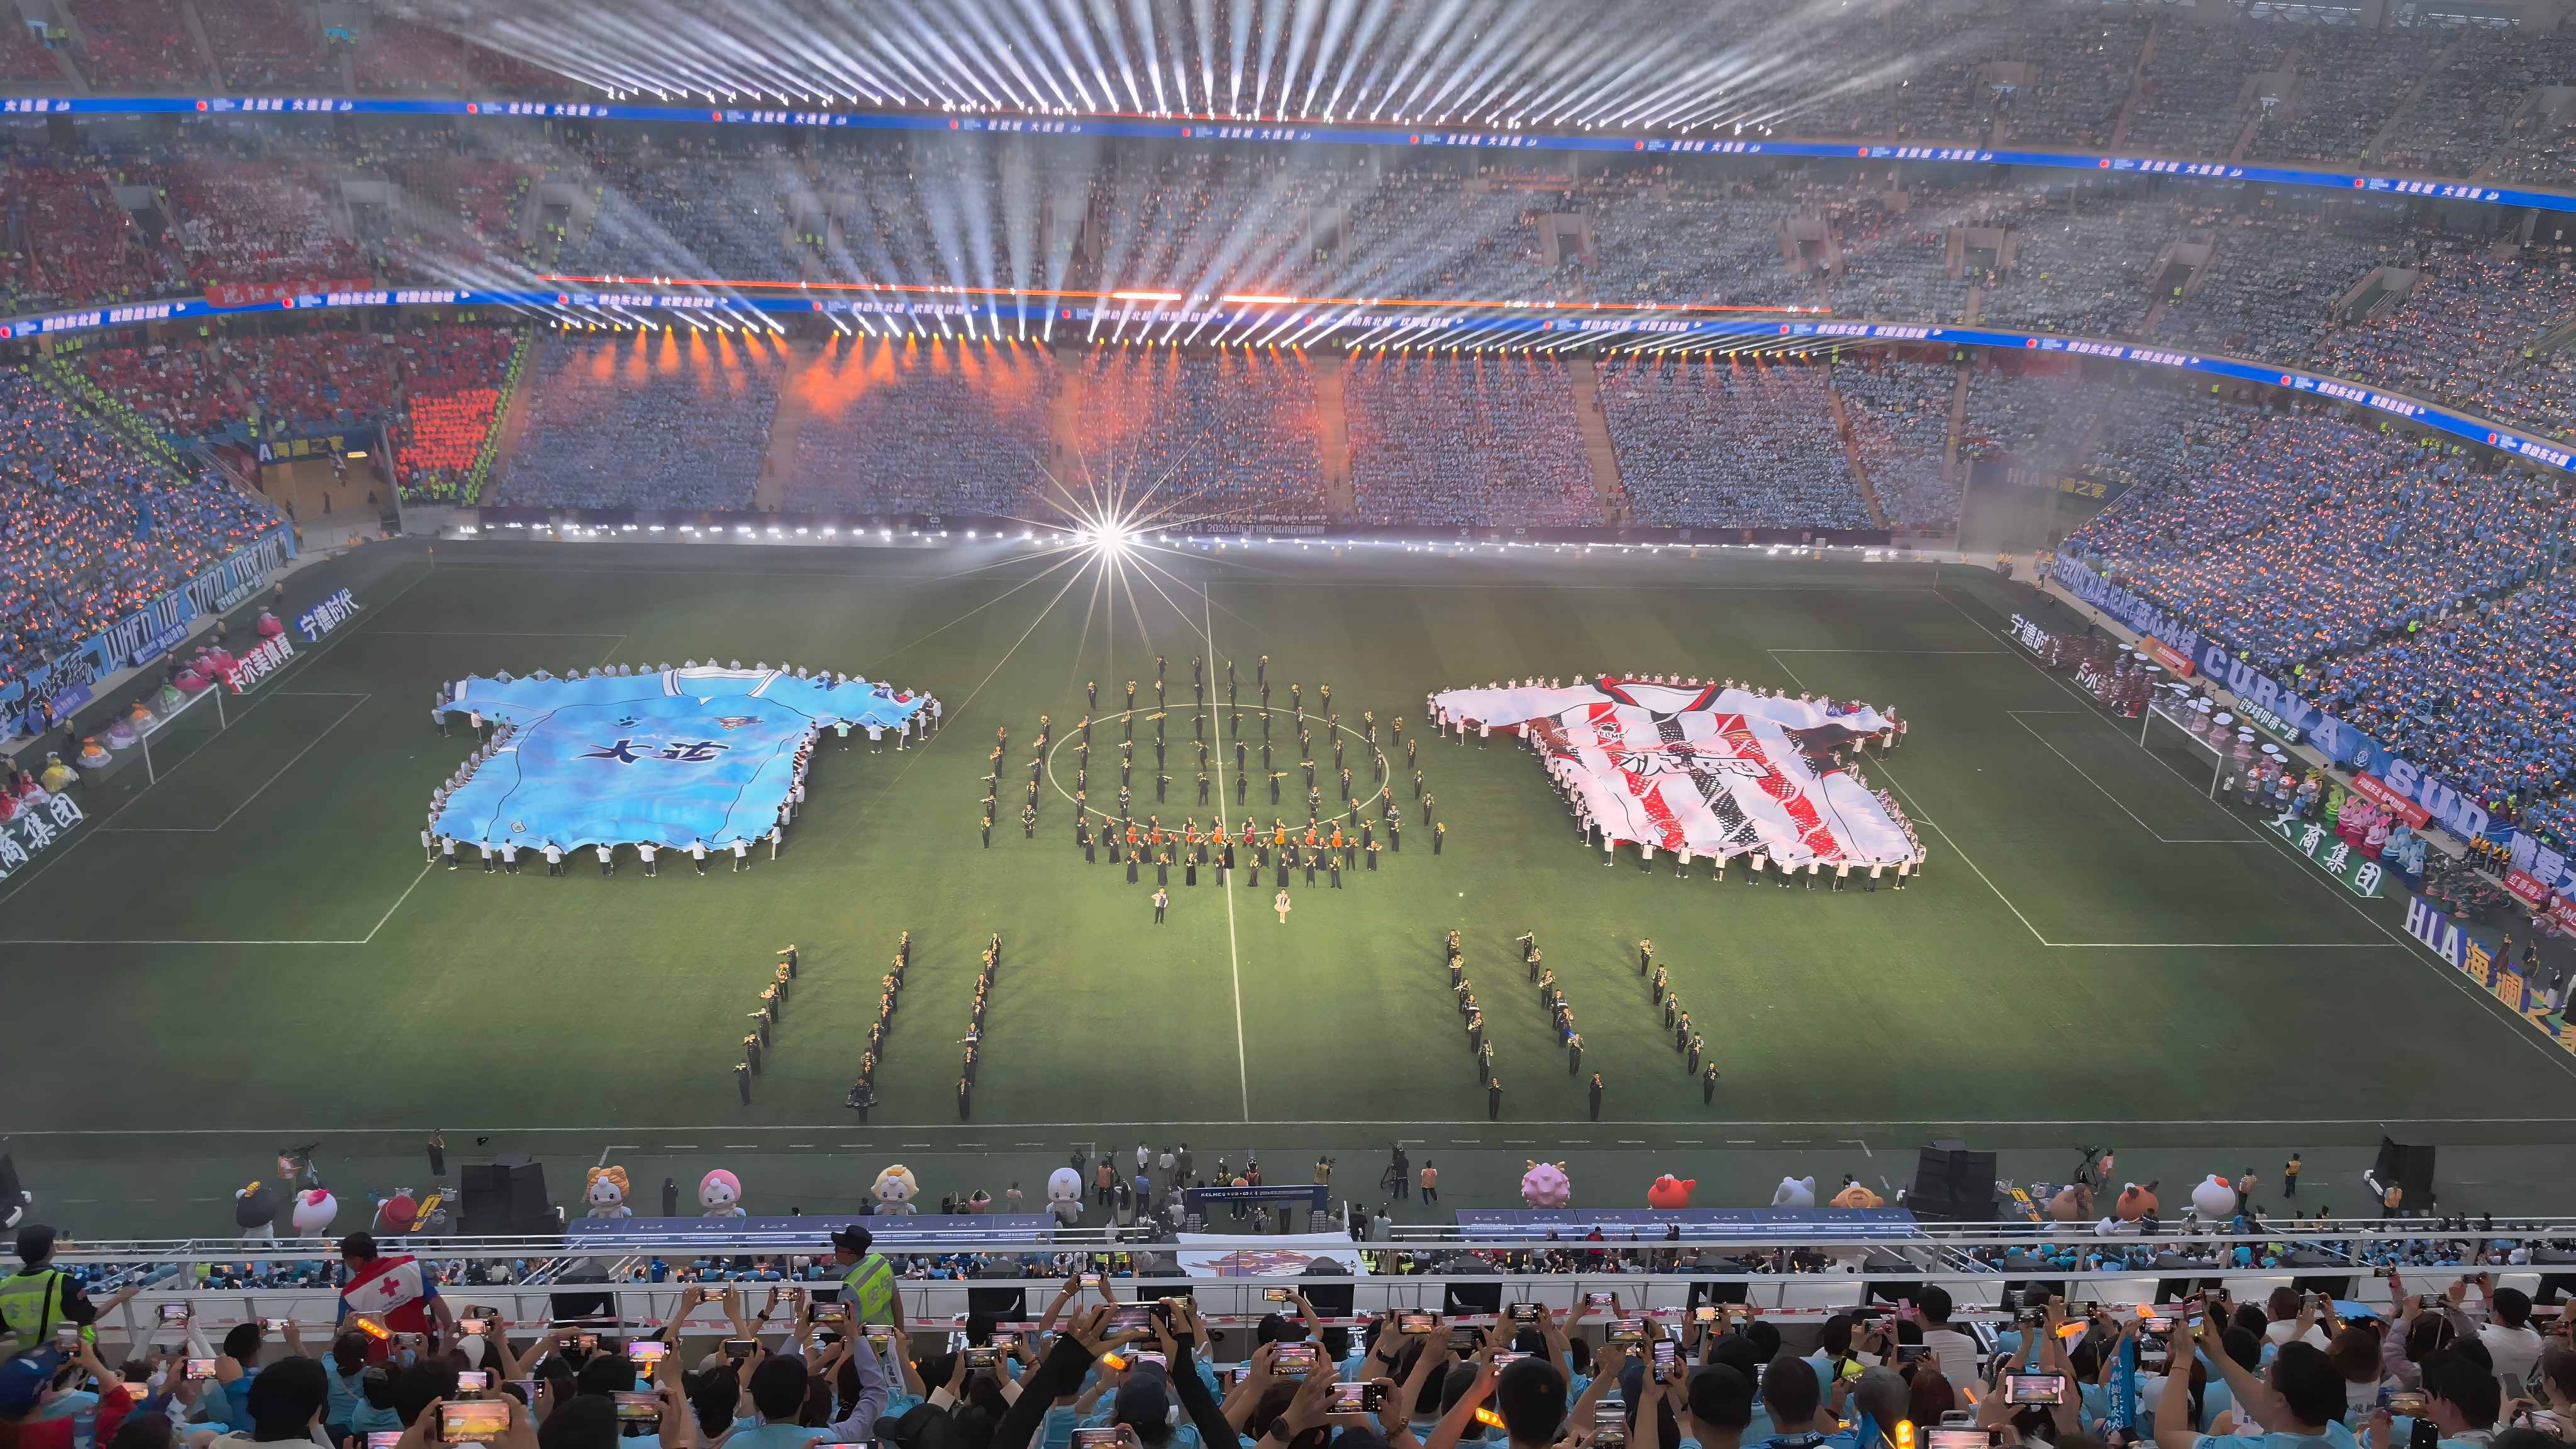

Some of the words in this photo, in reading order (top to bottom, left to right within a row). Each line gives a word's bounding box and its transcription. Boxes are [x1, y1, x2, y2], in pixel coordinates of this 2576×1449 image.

[299, 587, 360, 643] 宁德时代
[227, 632, 294, 693] 卡尔美体育
[2204, 645, 2339, 757] CURVA
[571, 739, 731, 765] 大连
[2384, 758, 2489, 840] SUD
[2270, 804, 2382, 896] 大商集团
[2405, 896, 2459, 967] HLA
